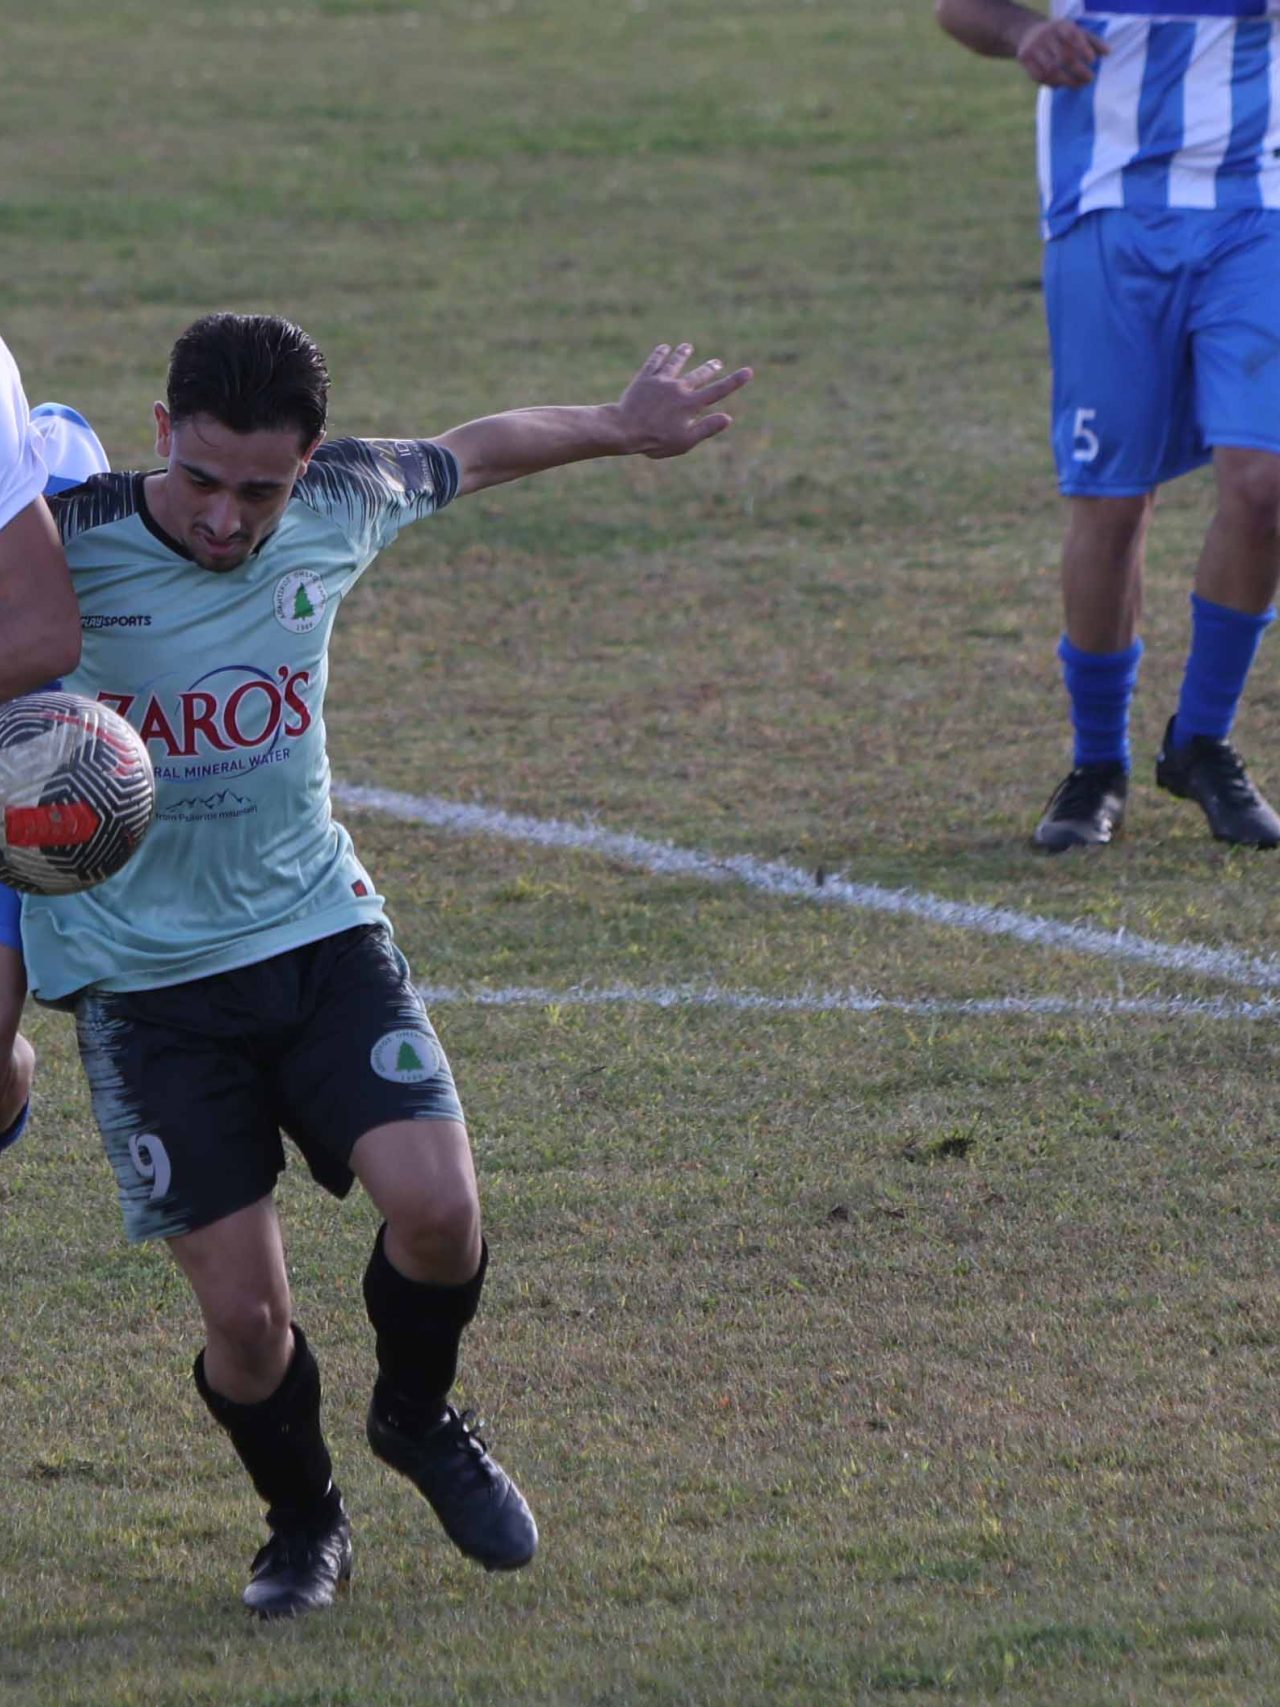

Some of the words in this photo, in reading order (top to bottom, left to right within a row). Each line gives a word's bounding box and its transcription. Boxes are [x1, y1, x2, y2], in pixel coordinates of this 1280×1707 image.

[1073, 409, 1099, 461] 5
[184, 759, 247, 778] MINERAL
[249, 748, 291, 767] WATER
[128, 1133, 171, 1199] 9
